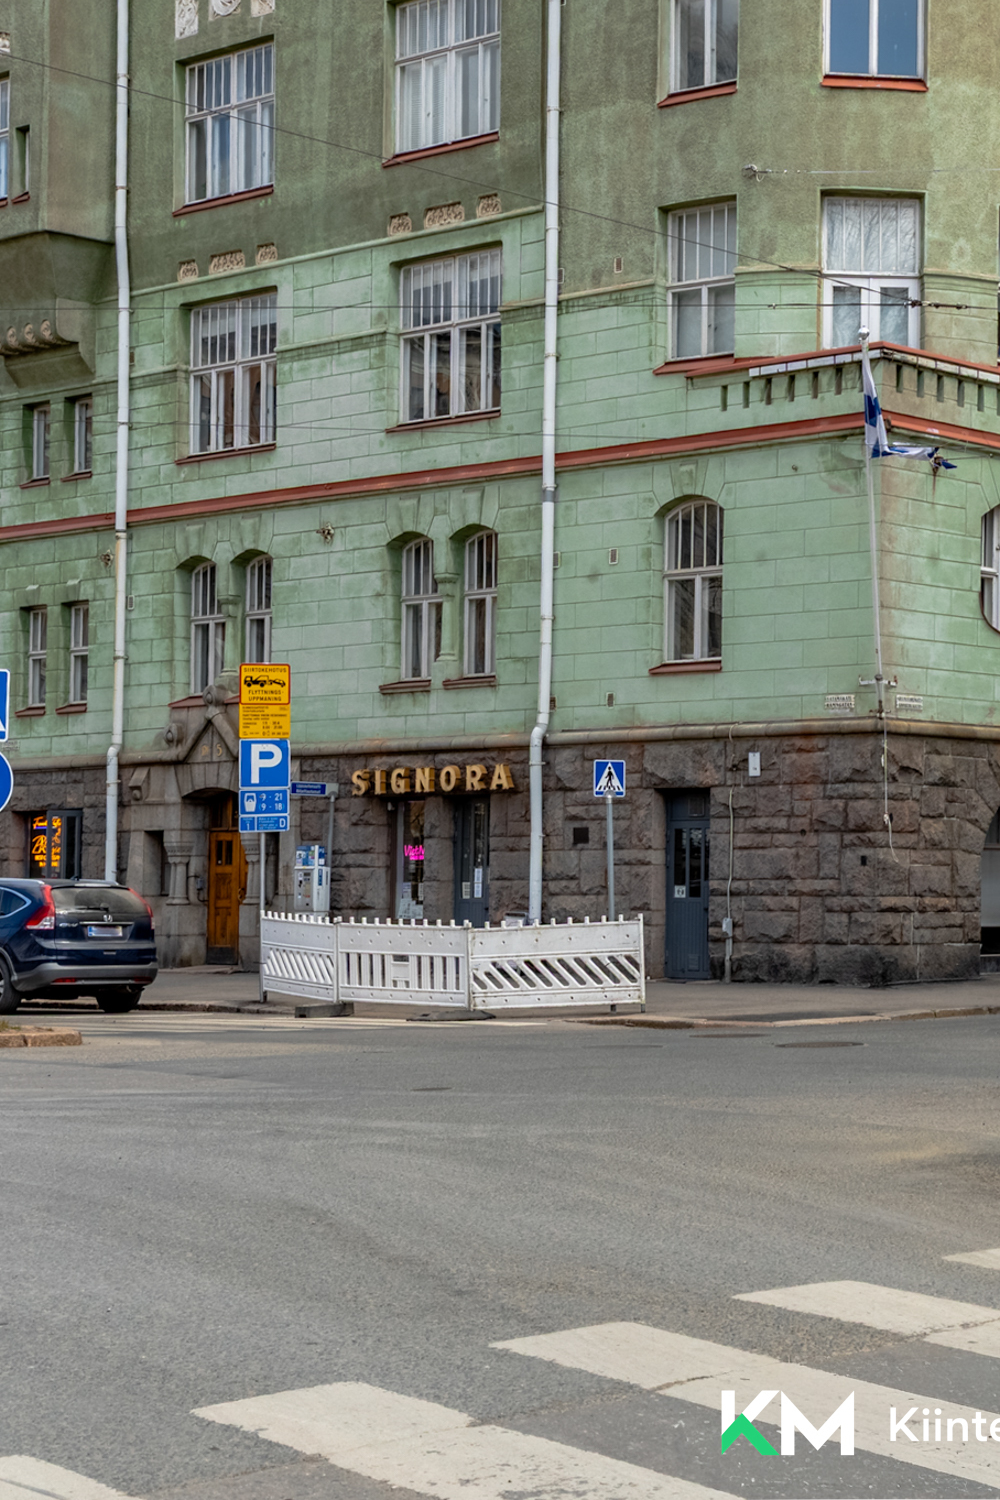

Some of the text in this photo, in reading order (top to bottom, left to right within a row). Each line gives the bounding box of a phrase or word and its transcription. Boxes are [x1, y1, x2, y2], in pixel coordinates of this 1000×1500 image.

[250, 743, 283, 784] P
[351, 763, 515, 796] SIGNORA
[274, 792, 283, 801] 21
[279, 818, 286, 828] D
